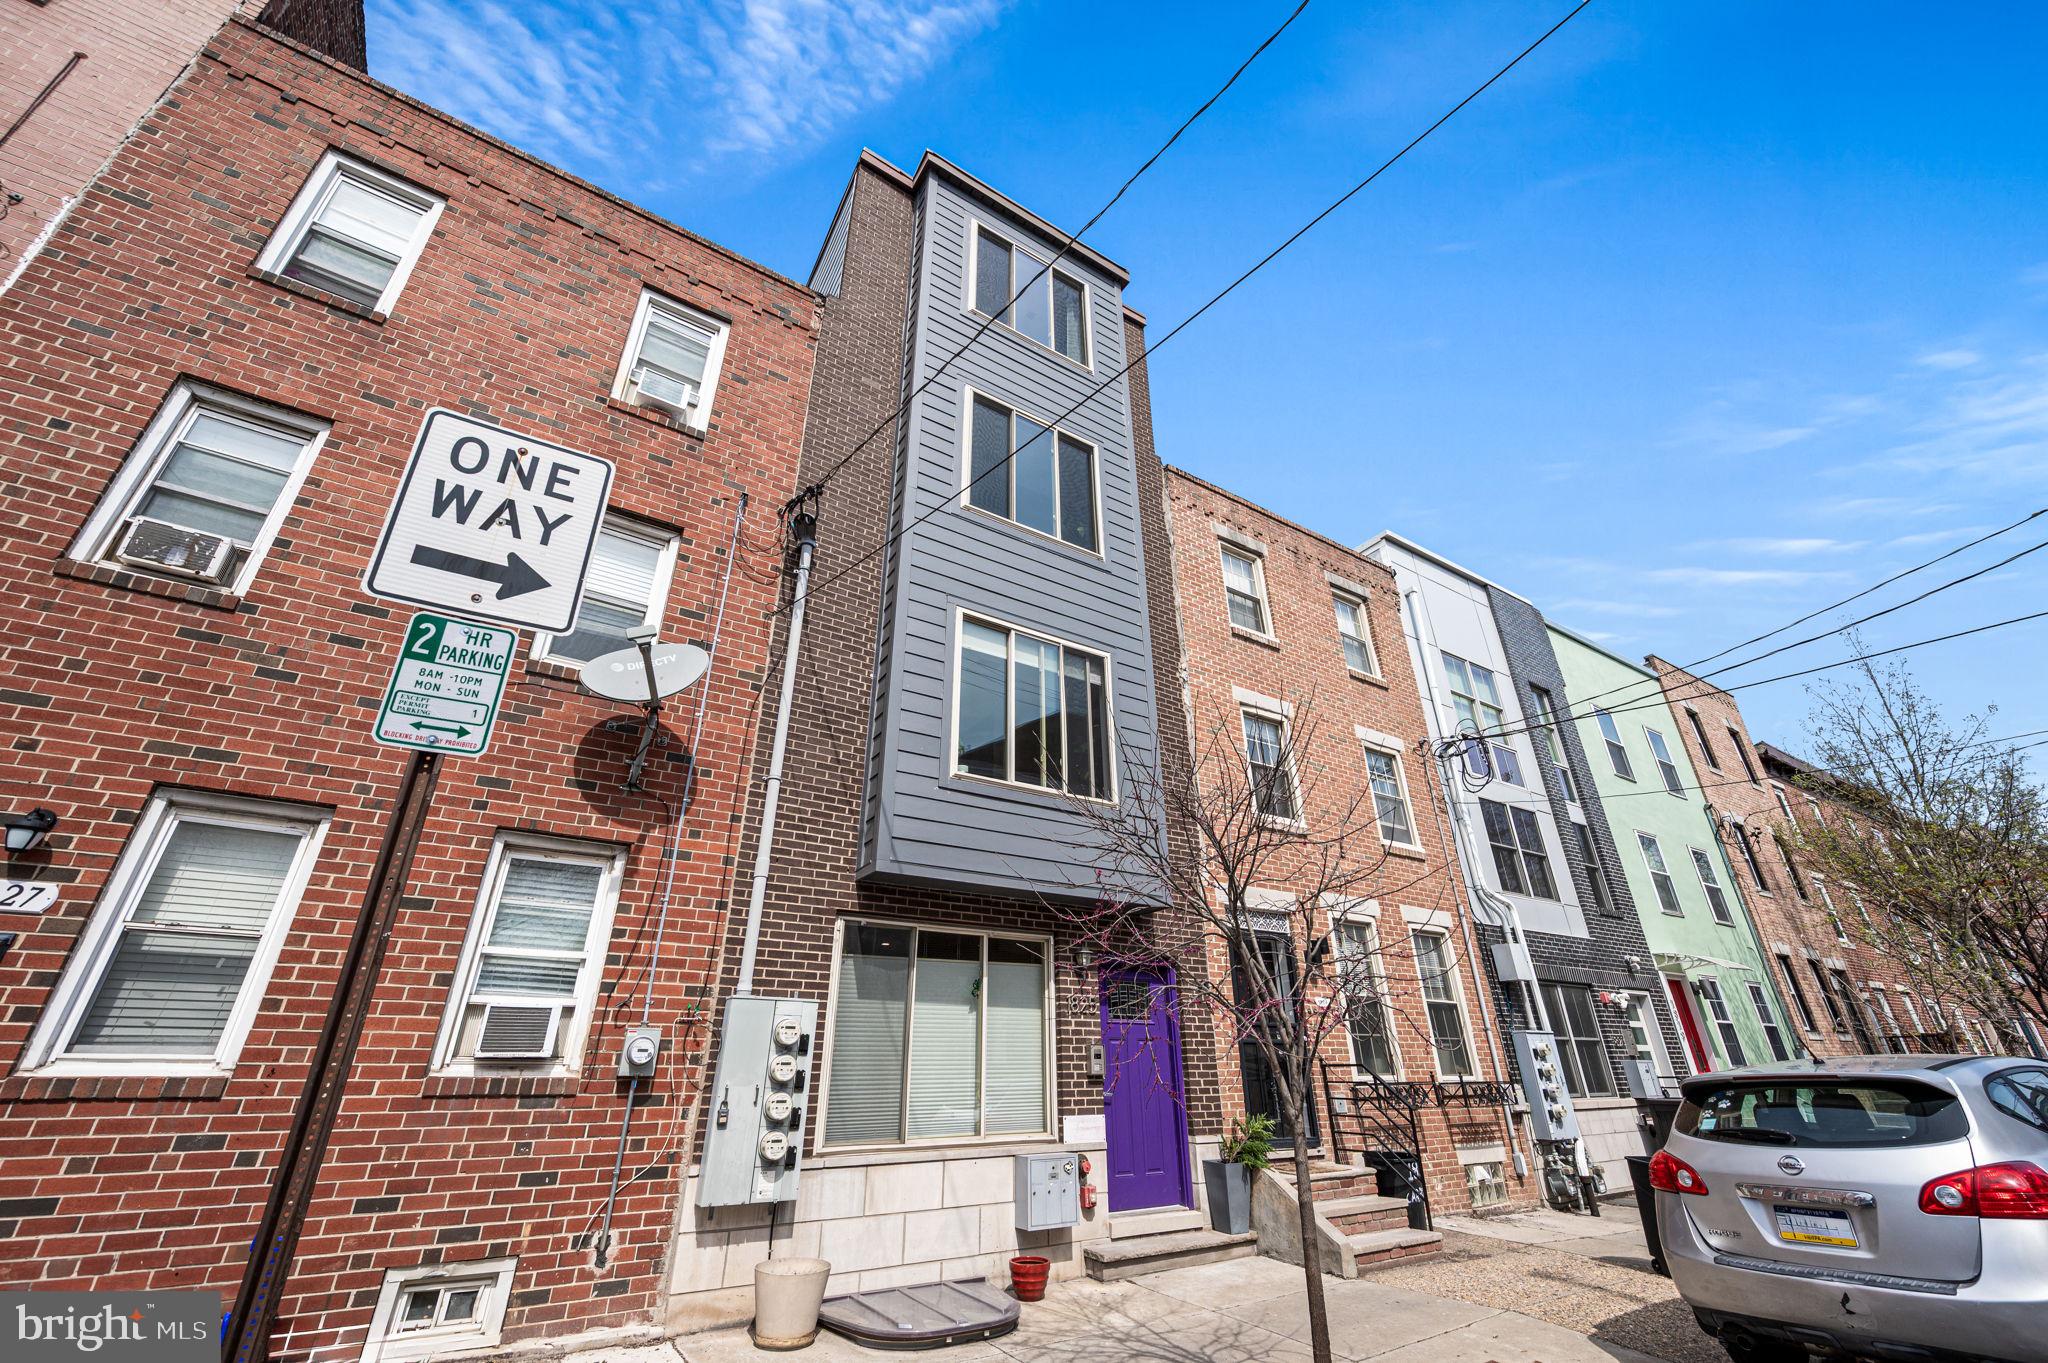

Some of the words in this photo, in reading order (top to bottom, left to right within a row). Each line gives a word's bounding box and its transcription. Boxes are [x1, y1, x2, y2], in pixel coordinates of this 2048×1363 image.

[450, 436, 580, 503] ONE
[431, 478, 573, 546] WAY
[411, 622, 436, 655] 2
[465, 632, 493, 648] HR
[438, 645, 504, 671] PARKING
[419, 668, 444, 680] 8AM
[400, 694, 429, 703] EXCEPT
[414, 680, 441, 692] MON
[456, 688, 480, 699] SUN
[396, 705, 431, 716] PARKING
[398, 699, 429, 709] PERMIT
[472, 709, 478, 718] 1
[383, 729, 413, 740] BLOCKING
[444, 740, 478, 750] PROHIBITED
[0, 884, 46, 908] 27
